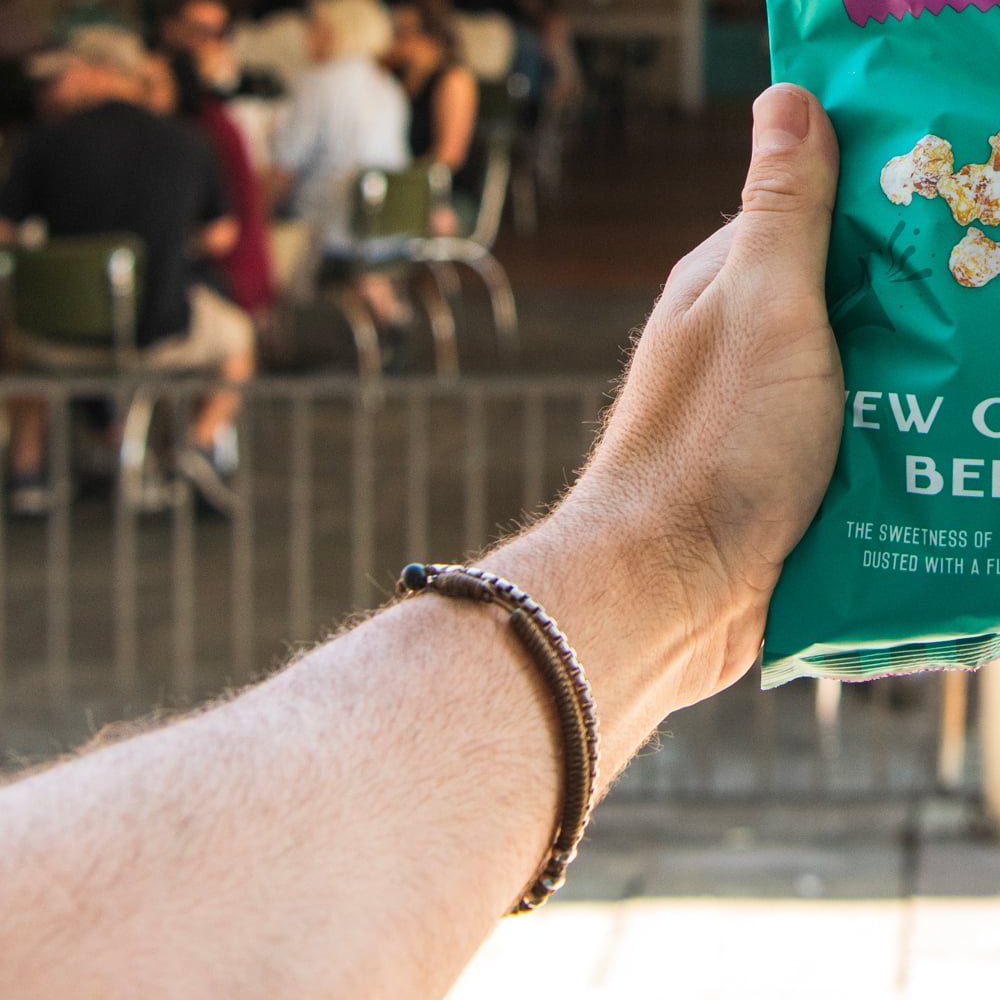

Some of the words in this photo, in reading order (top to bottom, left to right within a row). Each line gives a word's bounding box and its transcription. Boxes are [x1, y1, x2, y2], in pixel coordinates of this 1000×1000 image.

[844, 390, 945, 434] EW
[846, 521, 874, 540] THE
[879, 523, 967, 548] SWEETNESS
[974, 530, 993, 548] OF
[863, 550, 918, 572] DUSTED
[925, 556, 964, 574] WITH
[971, 558, 980, 575] A
